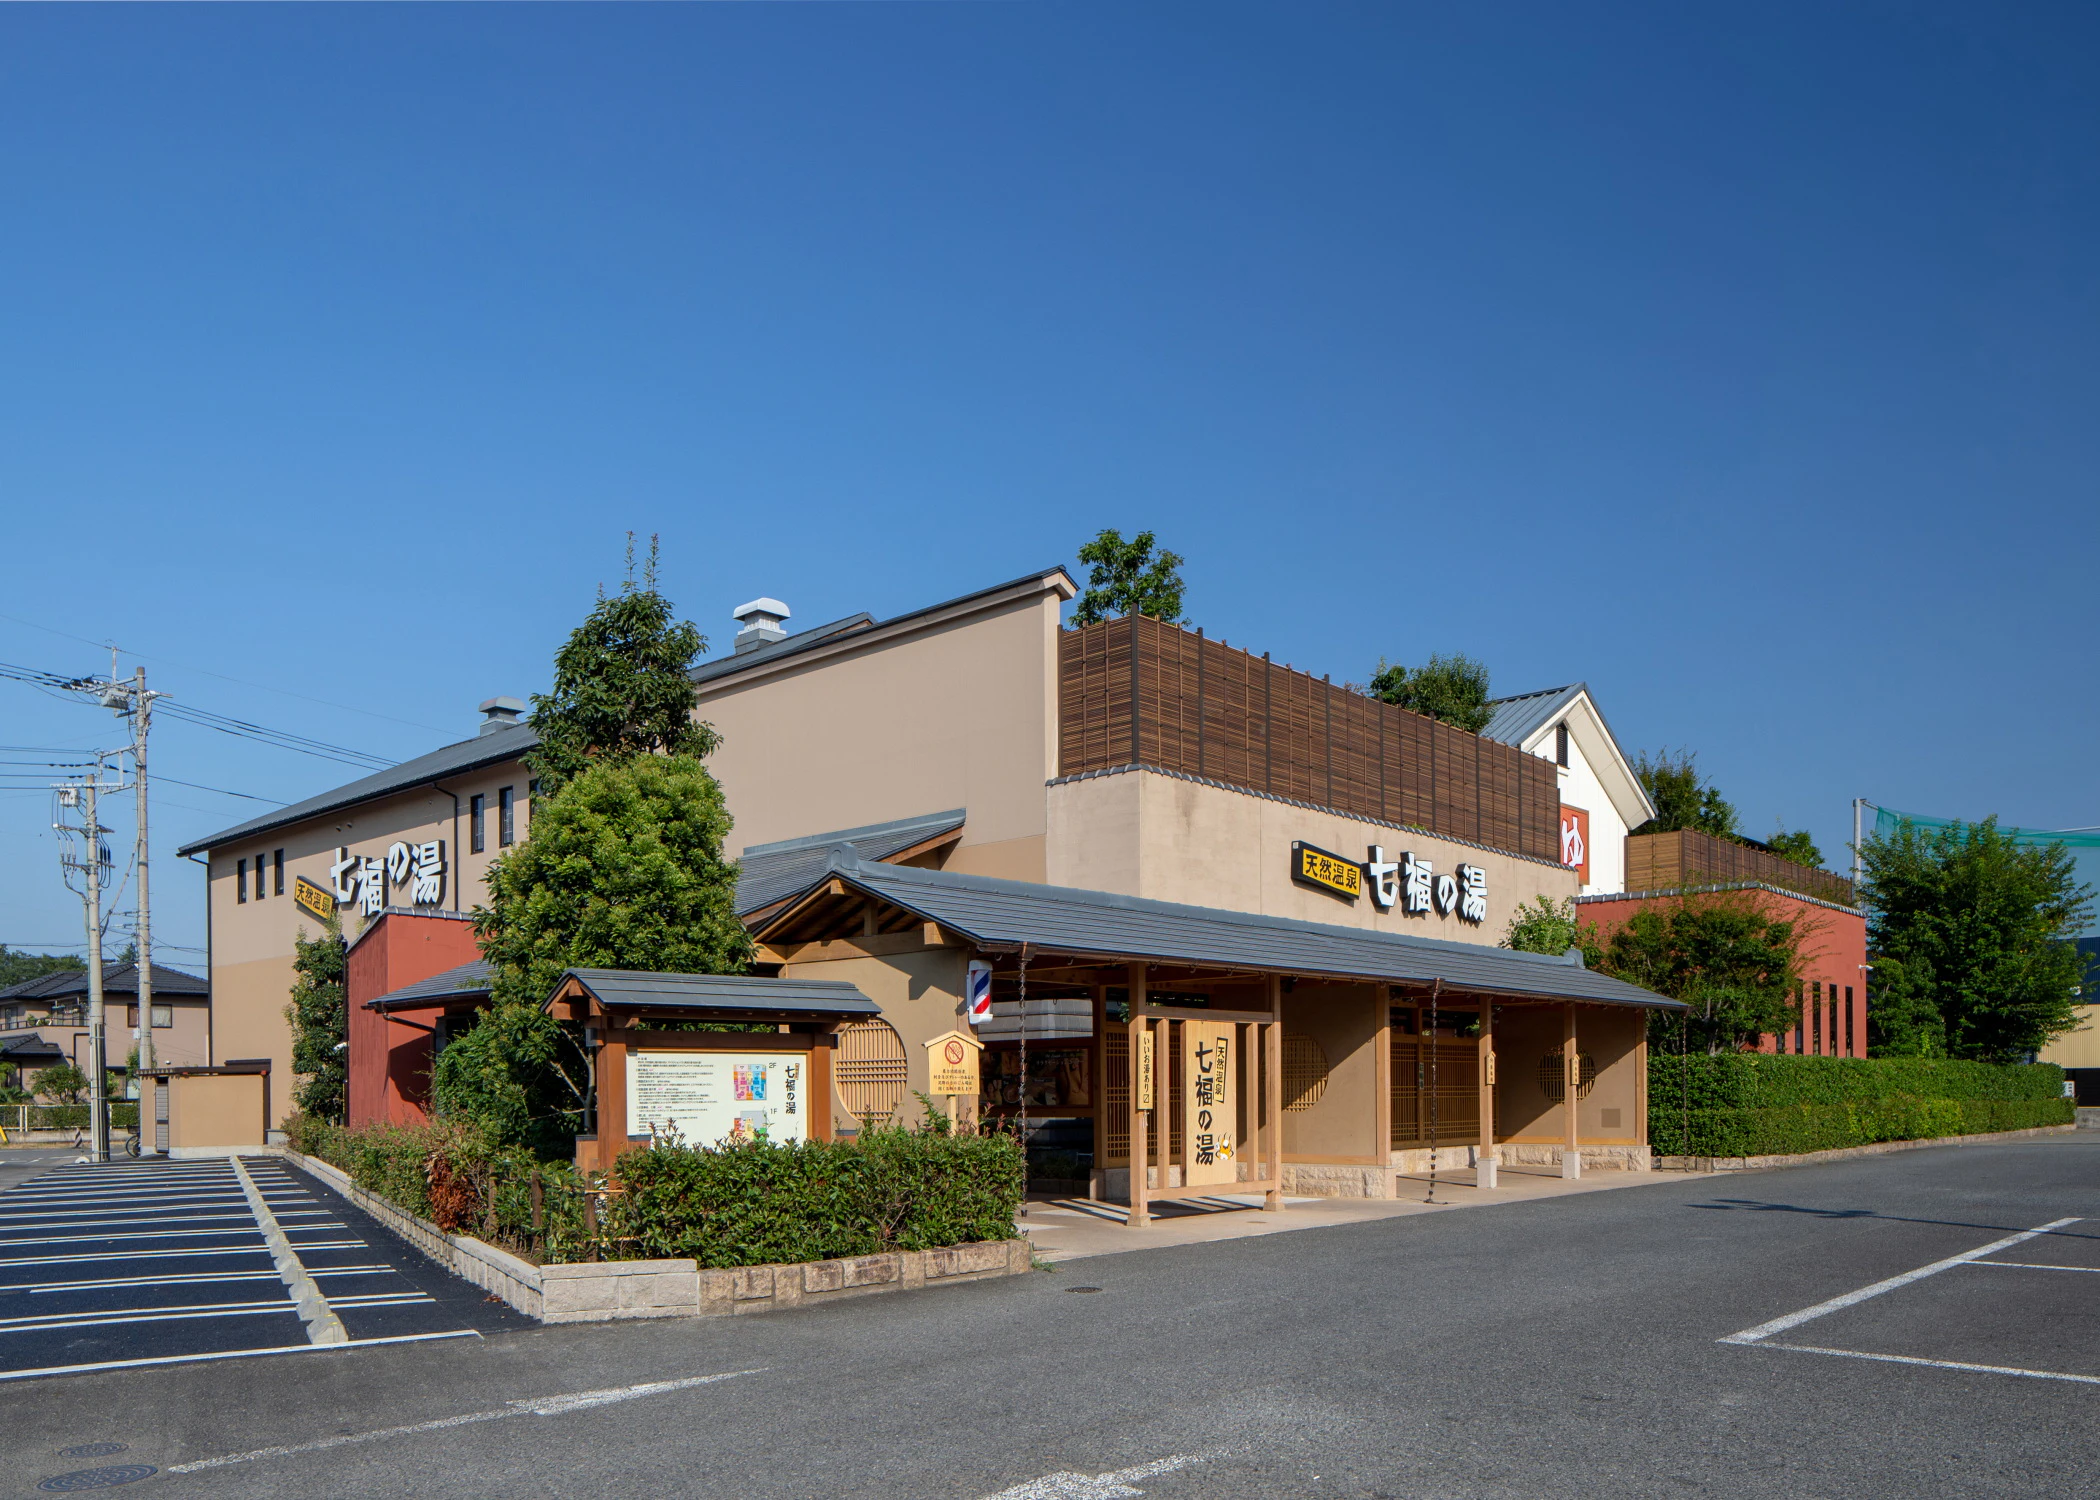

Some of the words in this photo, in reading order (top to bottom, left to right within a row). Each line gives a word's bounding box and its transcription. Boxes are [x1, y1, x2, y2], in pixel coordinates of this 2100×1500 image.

[1561, 815, 1585, 868] ゆ
[330, 840, 446, 917] 七福の湯
[1305, 853, 1357, 890] 天然温泉
[1366, 845, 1488, 922] 七福の湯
[297, 883, 332, 914] 天然温泉
[785, 1065, 796, 1114] 七福の湯
[1215, 1046, 1225, 1096] 天然温泉
[1195, 1041, 1214, 1165] 七福の湯
